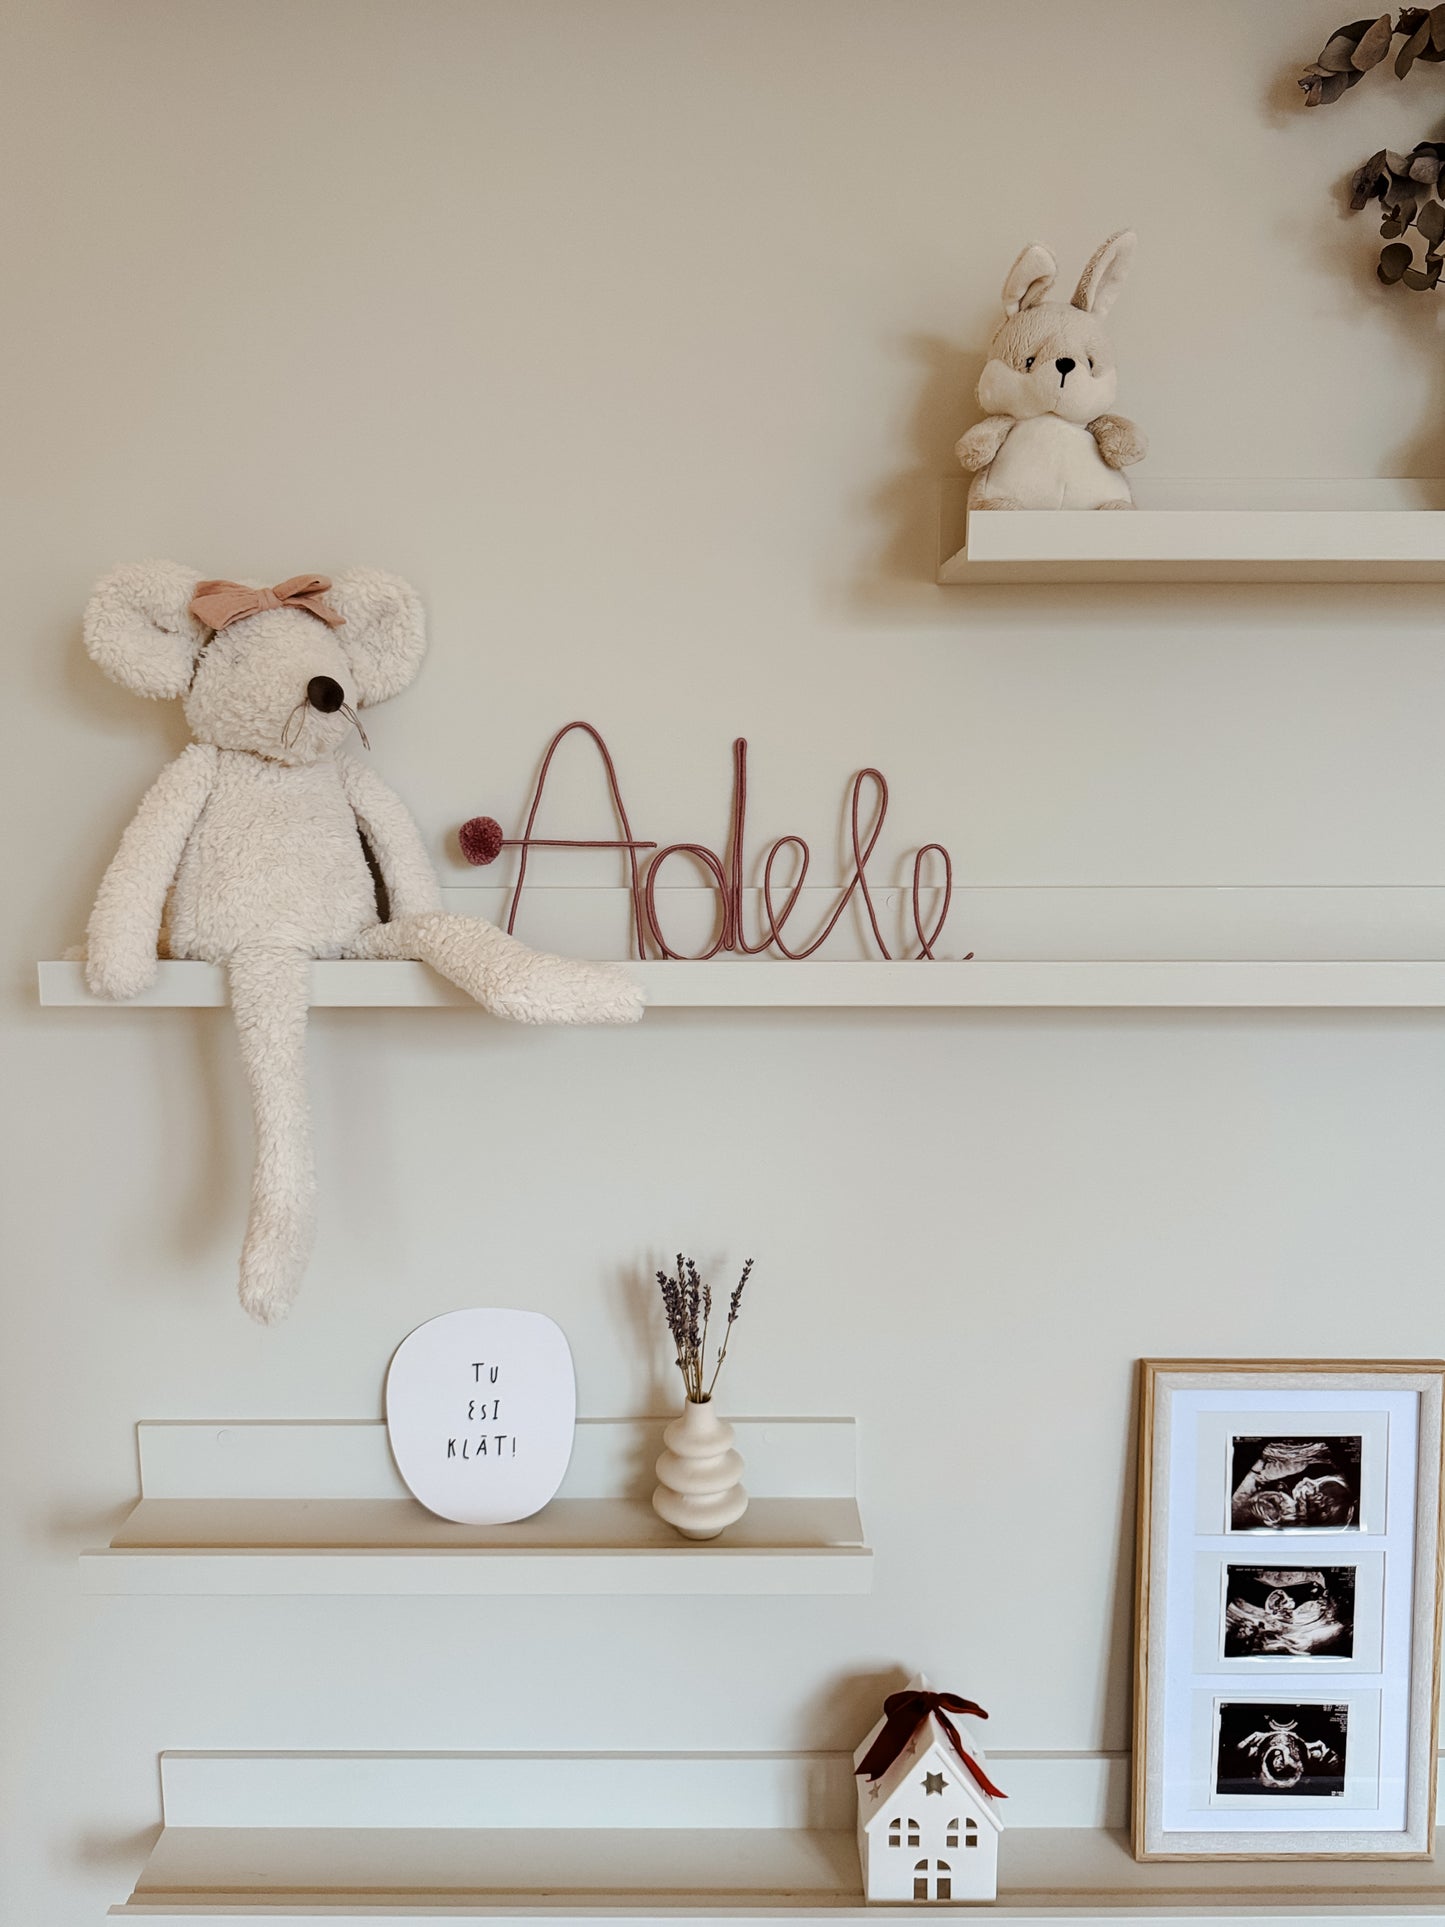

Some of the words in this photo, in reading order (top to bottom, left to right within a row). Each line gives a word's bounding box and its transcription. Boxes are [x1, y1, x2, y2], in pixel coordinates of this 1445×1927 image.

[499, 721, 974, 960] Adele
[471, 1362, 499, 1384] TU
[468, 1399, 501, 1421] ESI
[447, 1434, 517, 1460] KLĀT!
